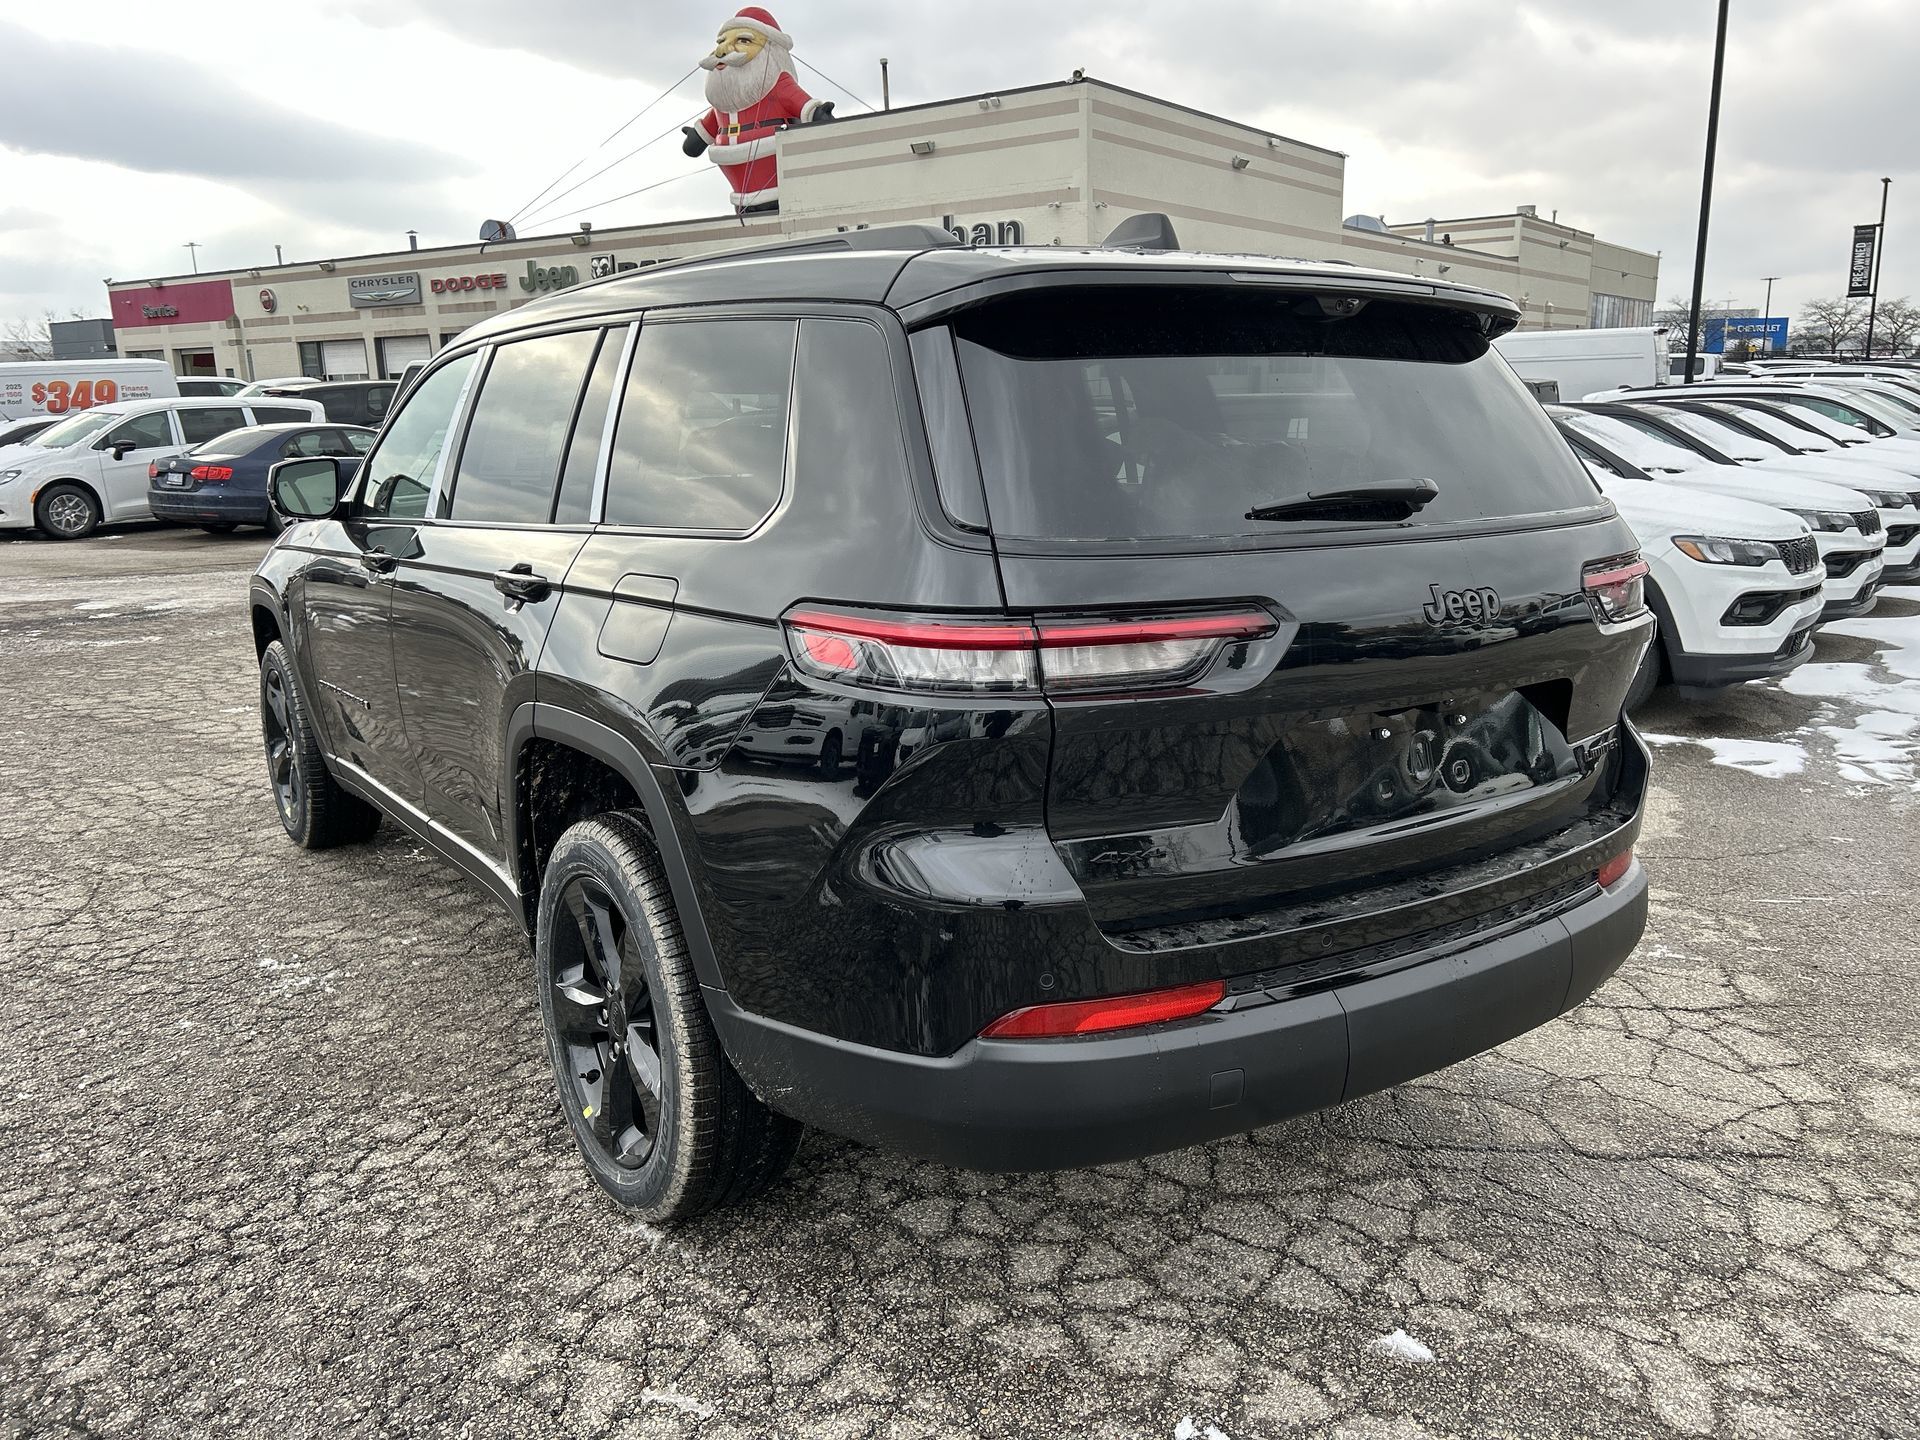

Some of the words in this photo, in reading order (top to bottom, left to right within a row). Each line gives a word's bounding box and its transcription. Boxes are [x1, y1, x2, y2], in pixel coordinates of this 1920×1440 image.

[518, 260, 579, 292] Jeep
[1851, 242, 1867, 288] PRE-OWNED
[351, 276, 414, 289] CHRYSLER
[430, 273, 506, 293] DODGE
[143, 304, 178, 318] Service
[32, 380, 118, 414] $349
[1422, 583, 1501, 628] Jeep
